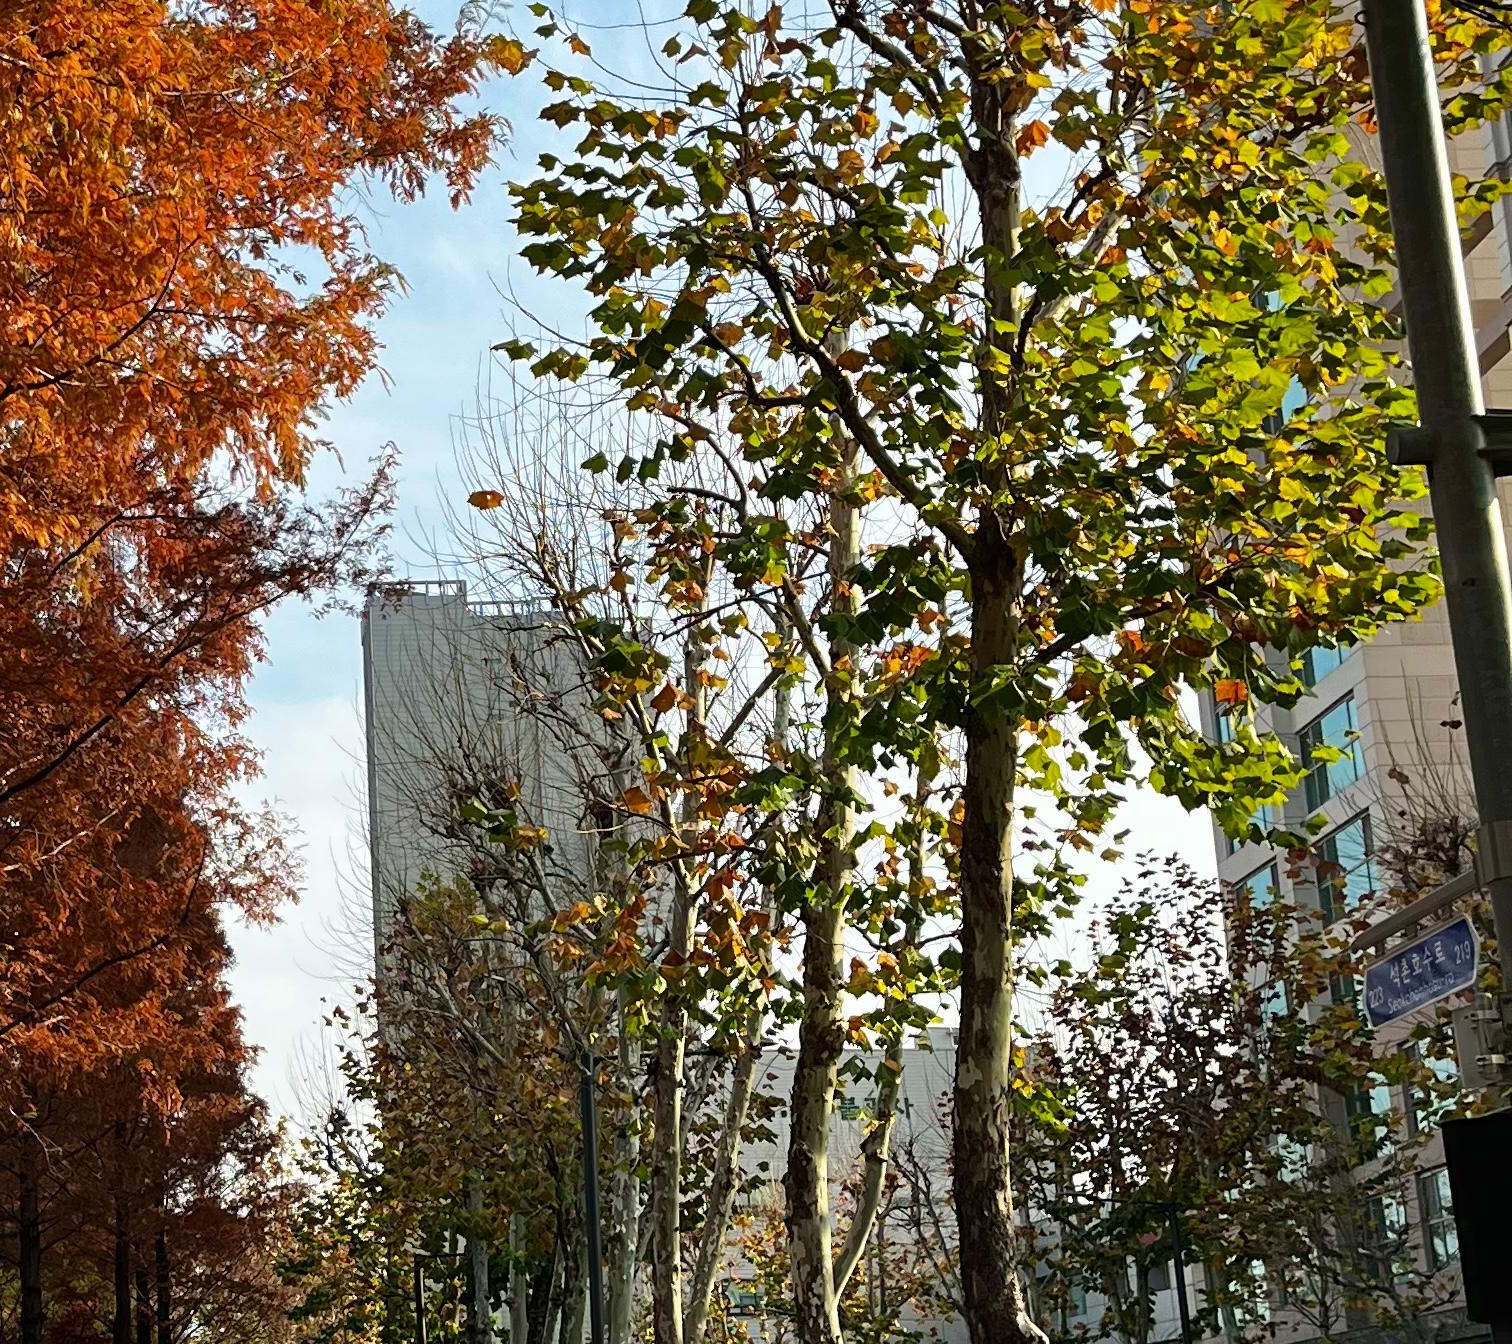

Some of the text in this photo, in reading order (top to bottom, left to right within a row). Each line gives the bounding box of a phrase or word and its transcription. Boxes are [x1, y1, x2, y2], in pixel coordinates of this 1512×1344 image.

[1390, 940, 1446, 987] 석촌호수로
[1455, 940, 1471, 965] 219
[1368, 986, 1384, 1009] 223
